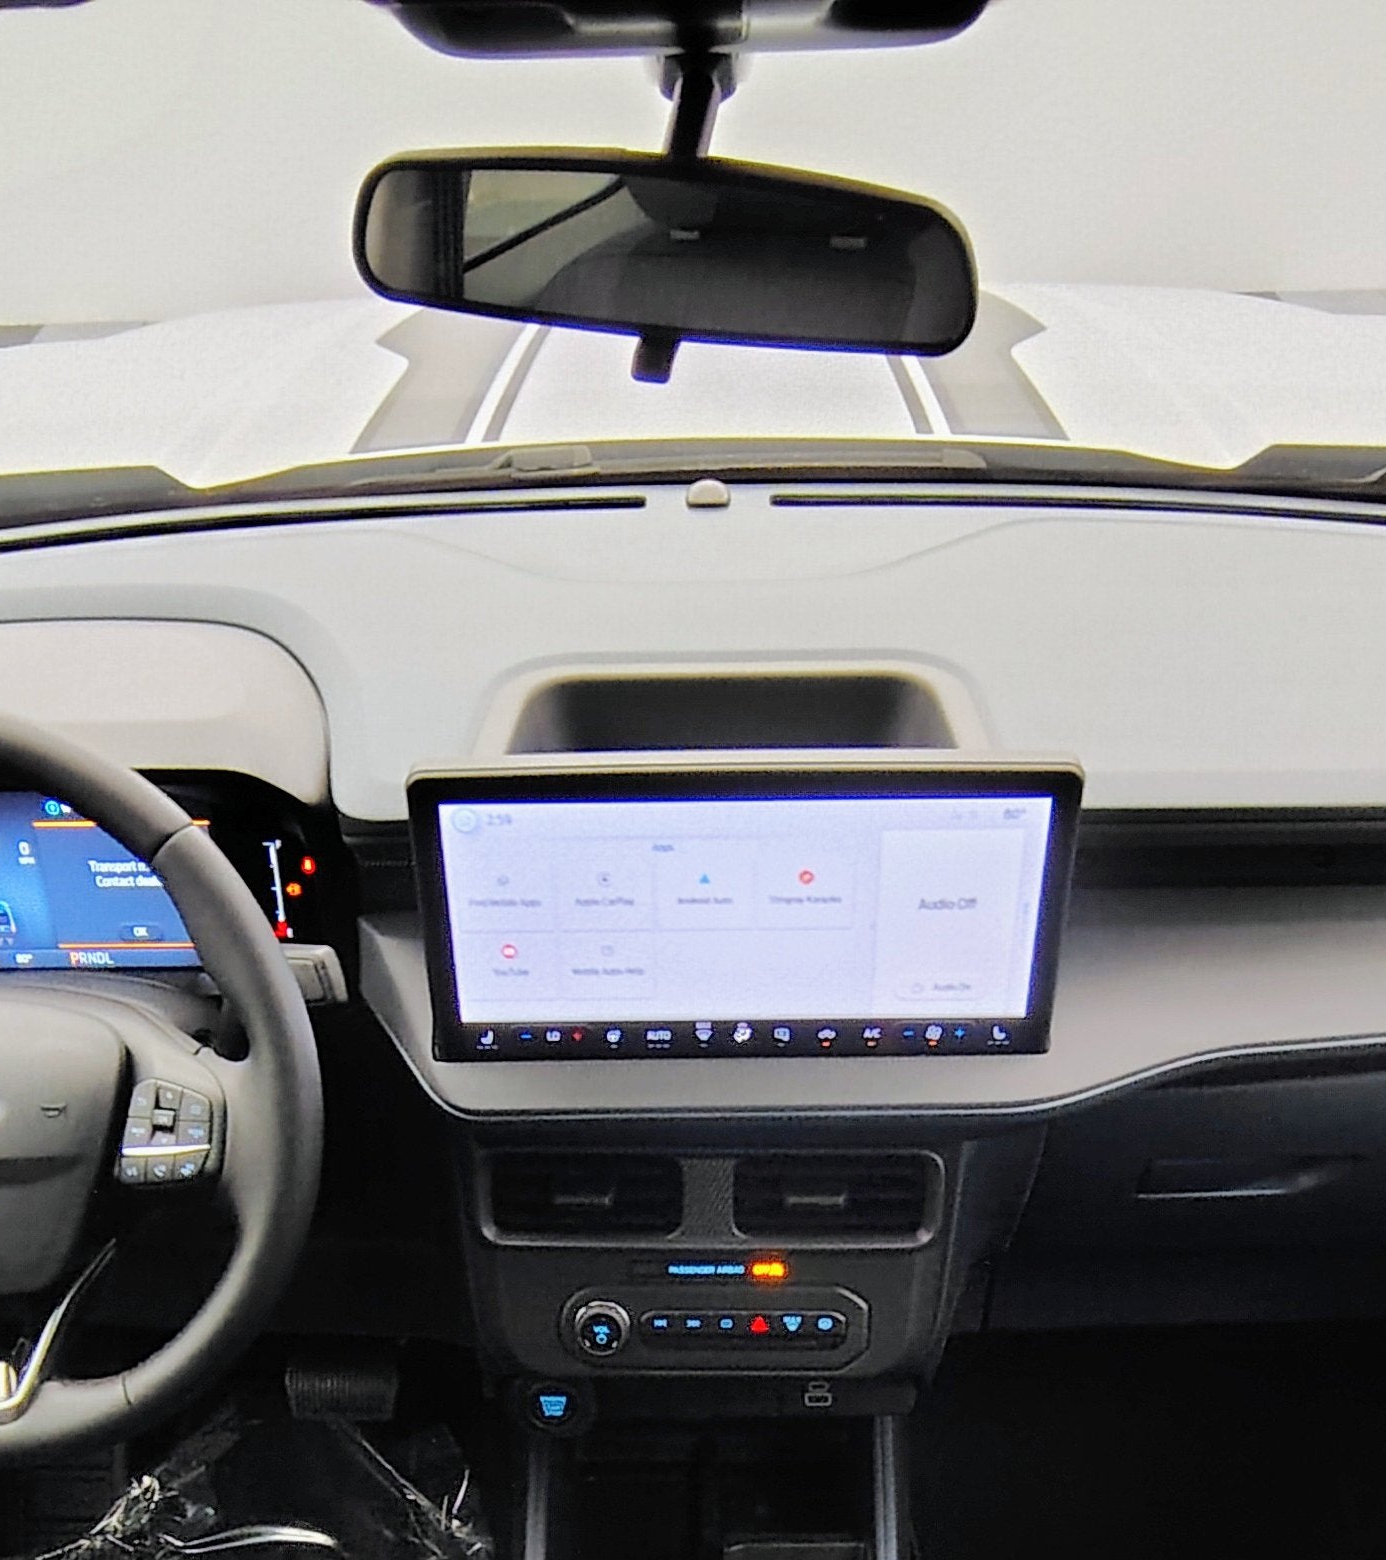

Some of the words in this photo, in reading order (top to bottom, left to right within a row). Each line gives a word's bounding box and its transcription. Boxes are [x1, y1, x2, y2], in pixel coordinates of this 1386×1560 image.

[95, 875, 136, 888] Contact
[917, 896, 956, 911] Audio
[69, 951, 114, 966] PRNDL
